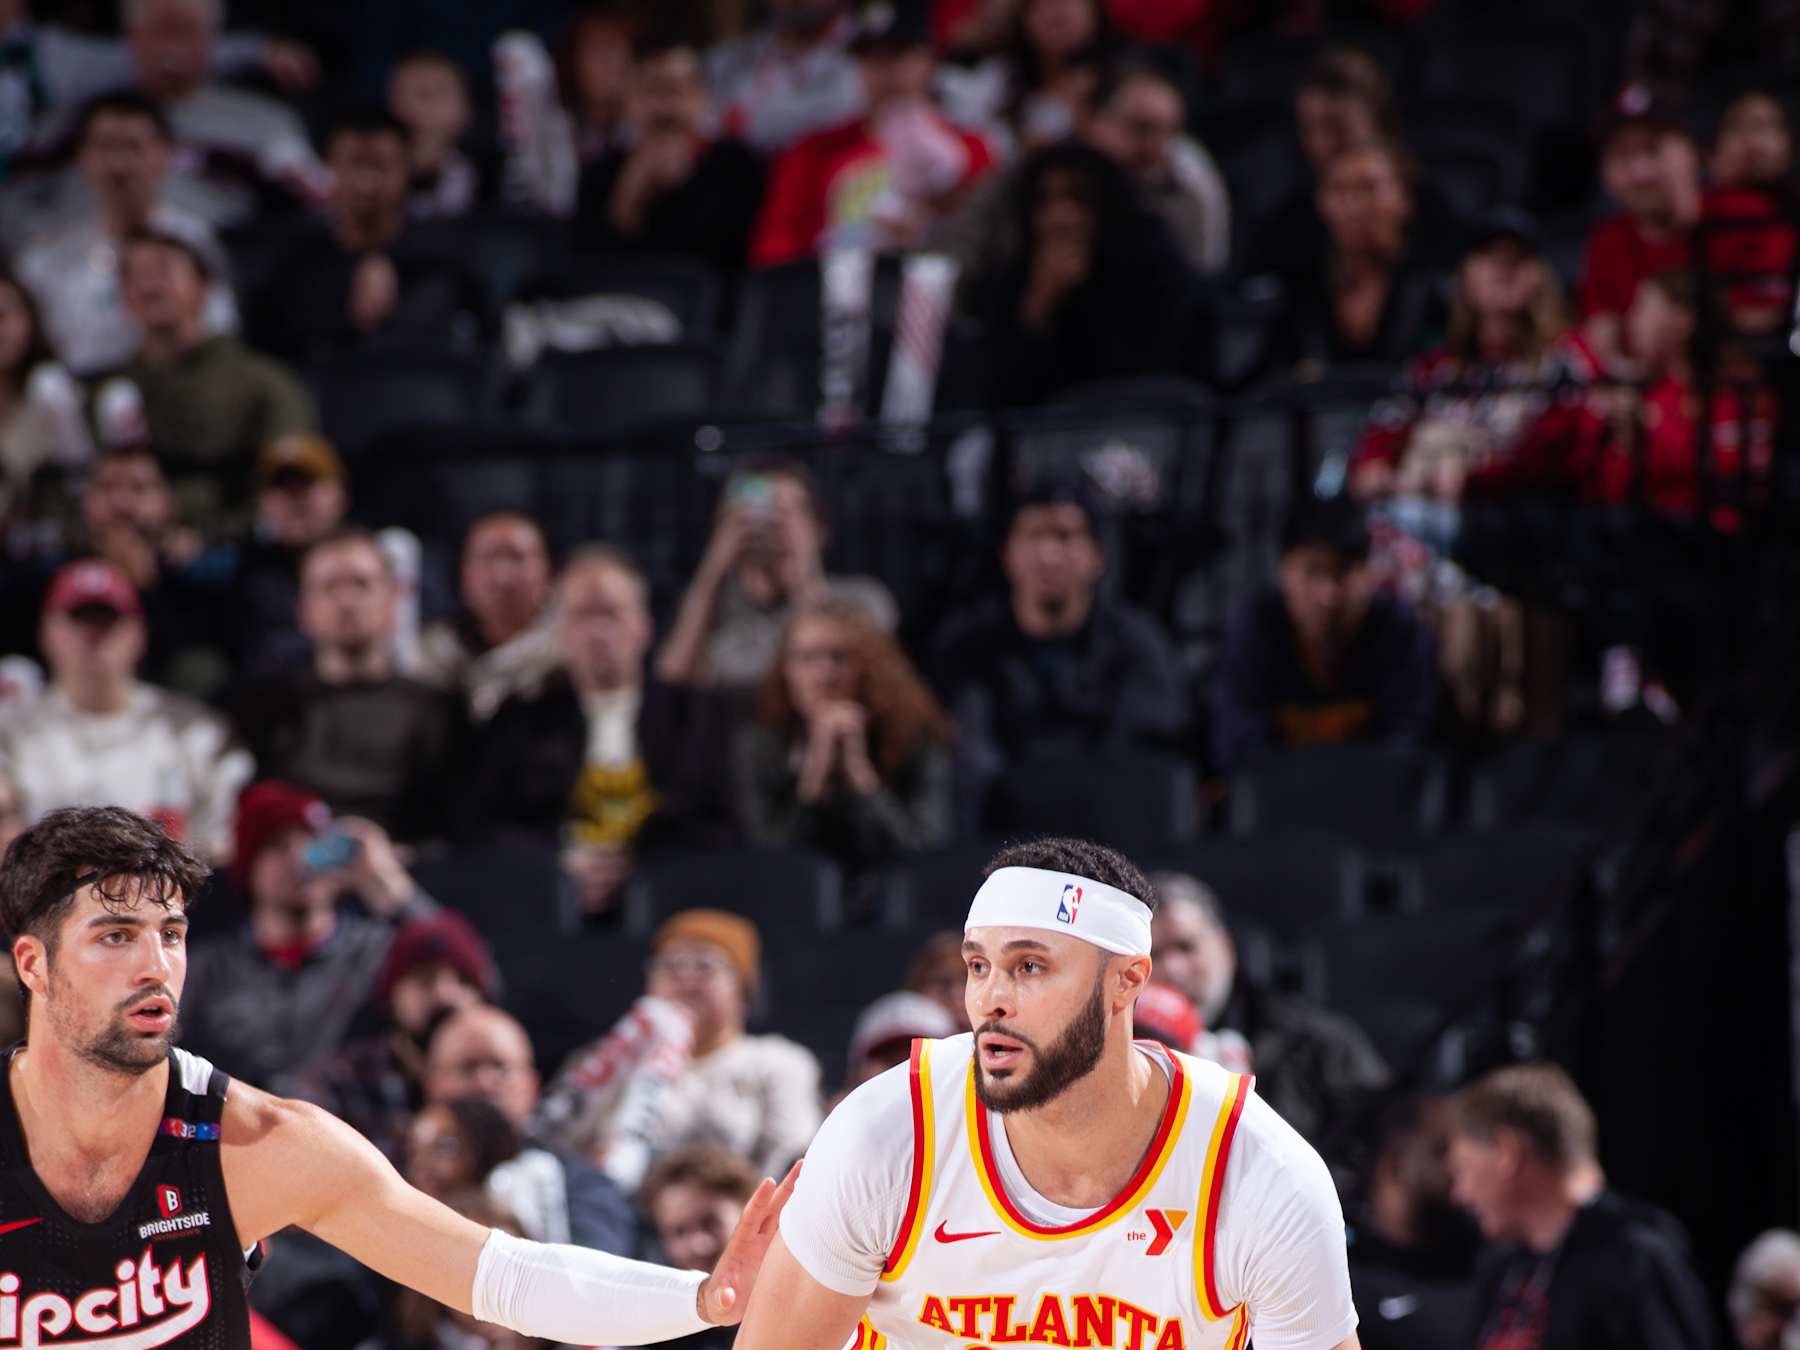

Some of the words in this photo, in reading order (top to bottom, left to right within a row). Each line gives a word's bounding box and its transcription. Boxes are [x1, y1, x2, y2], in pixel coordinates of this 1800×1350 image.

[165, 1189, 179, 1212] B
[138, 1213, 211, 1239] BRIGHTSIDE
[1127, 1230, 1147, 1241] the
